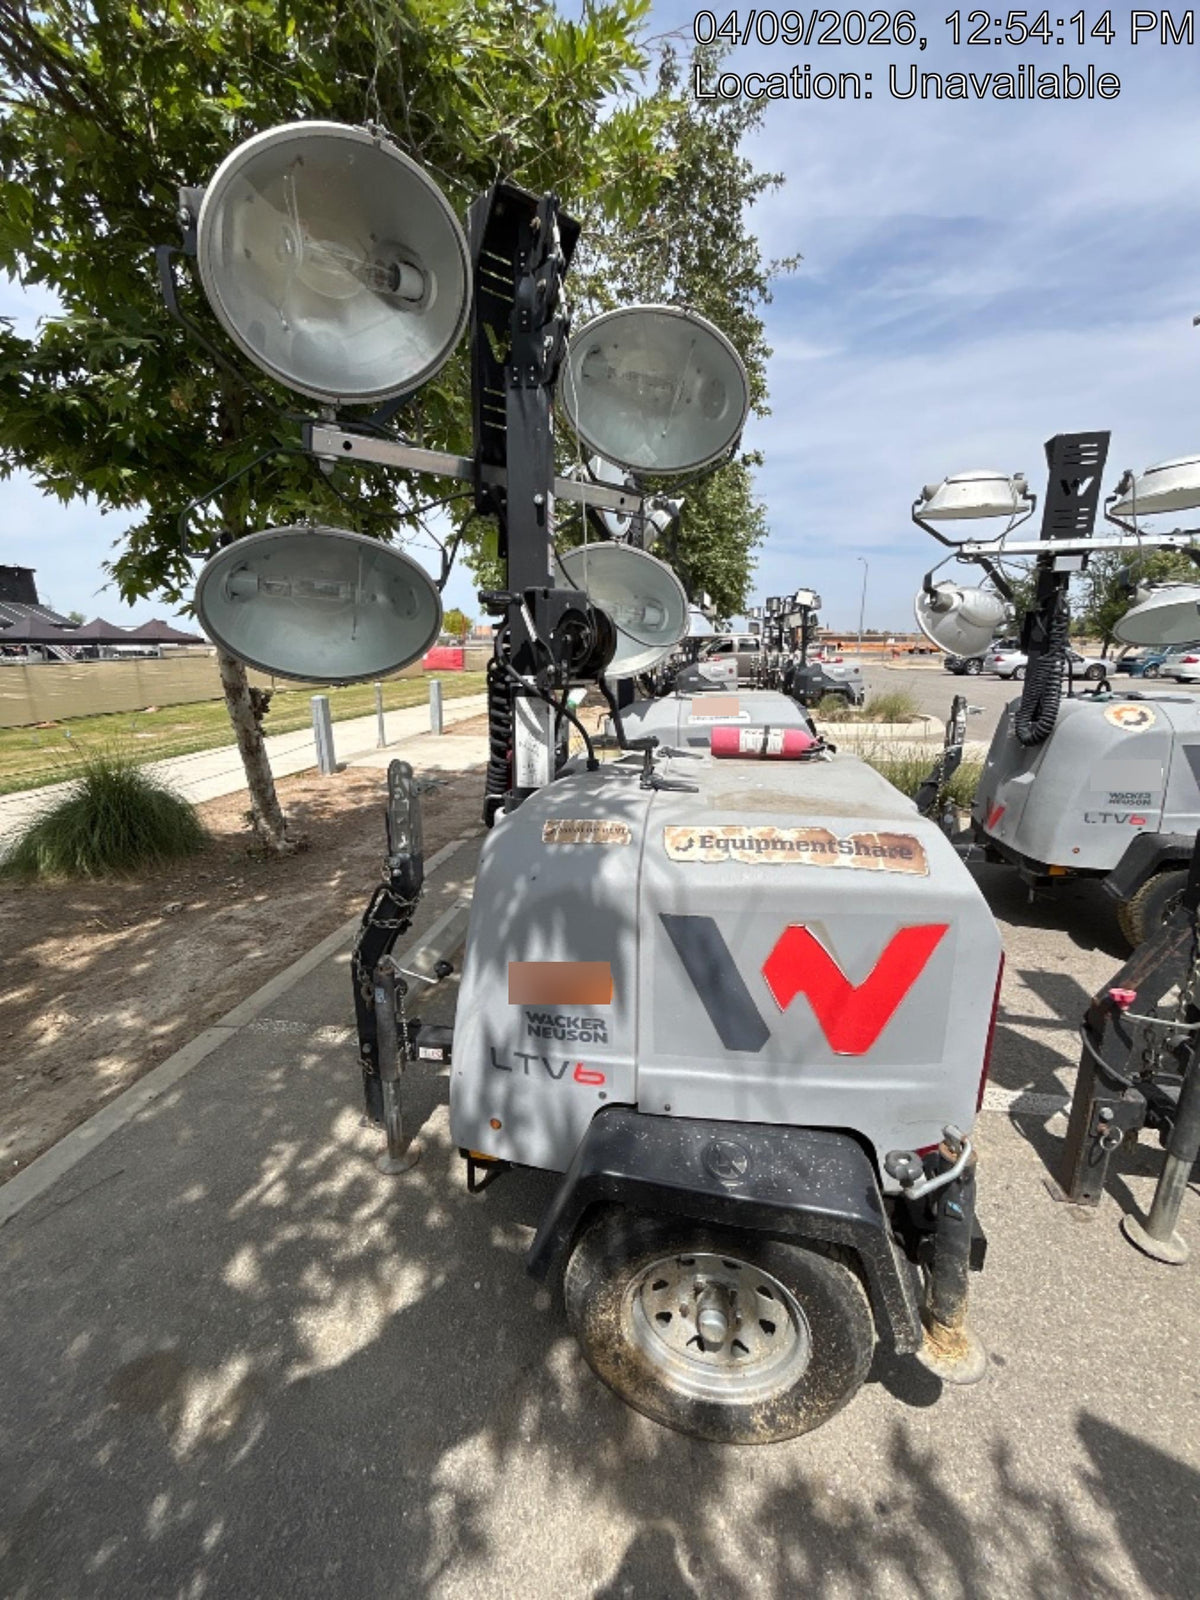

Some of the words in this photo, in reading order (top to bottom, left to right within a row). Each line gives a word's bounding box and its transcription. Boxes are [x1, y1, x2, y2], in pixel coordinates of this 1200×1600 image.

[1084, 811, 1146, 826] LTV6
[699, 834, 913, 861] EquipmentShare
[525, 1010, 607, 1031] WACKER
[527, 1023, 609, 1044] NEUSON
[490, 1046, 606, 1085] LTV6
